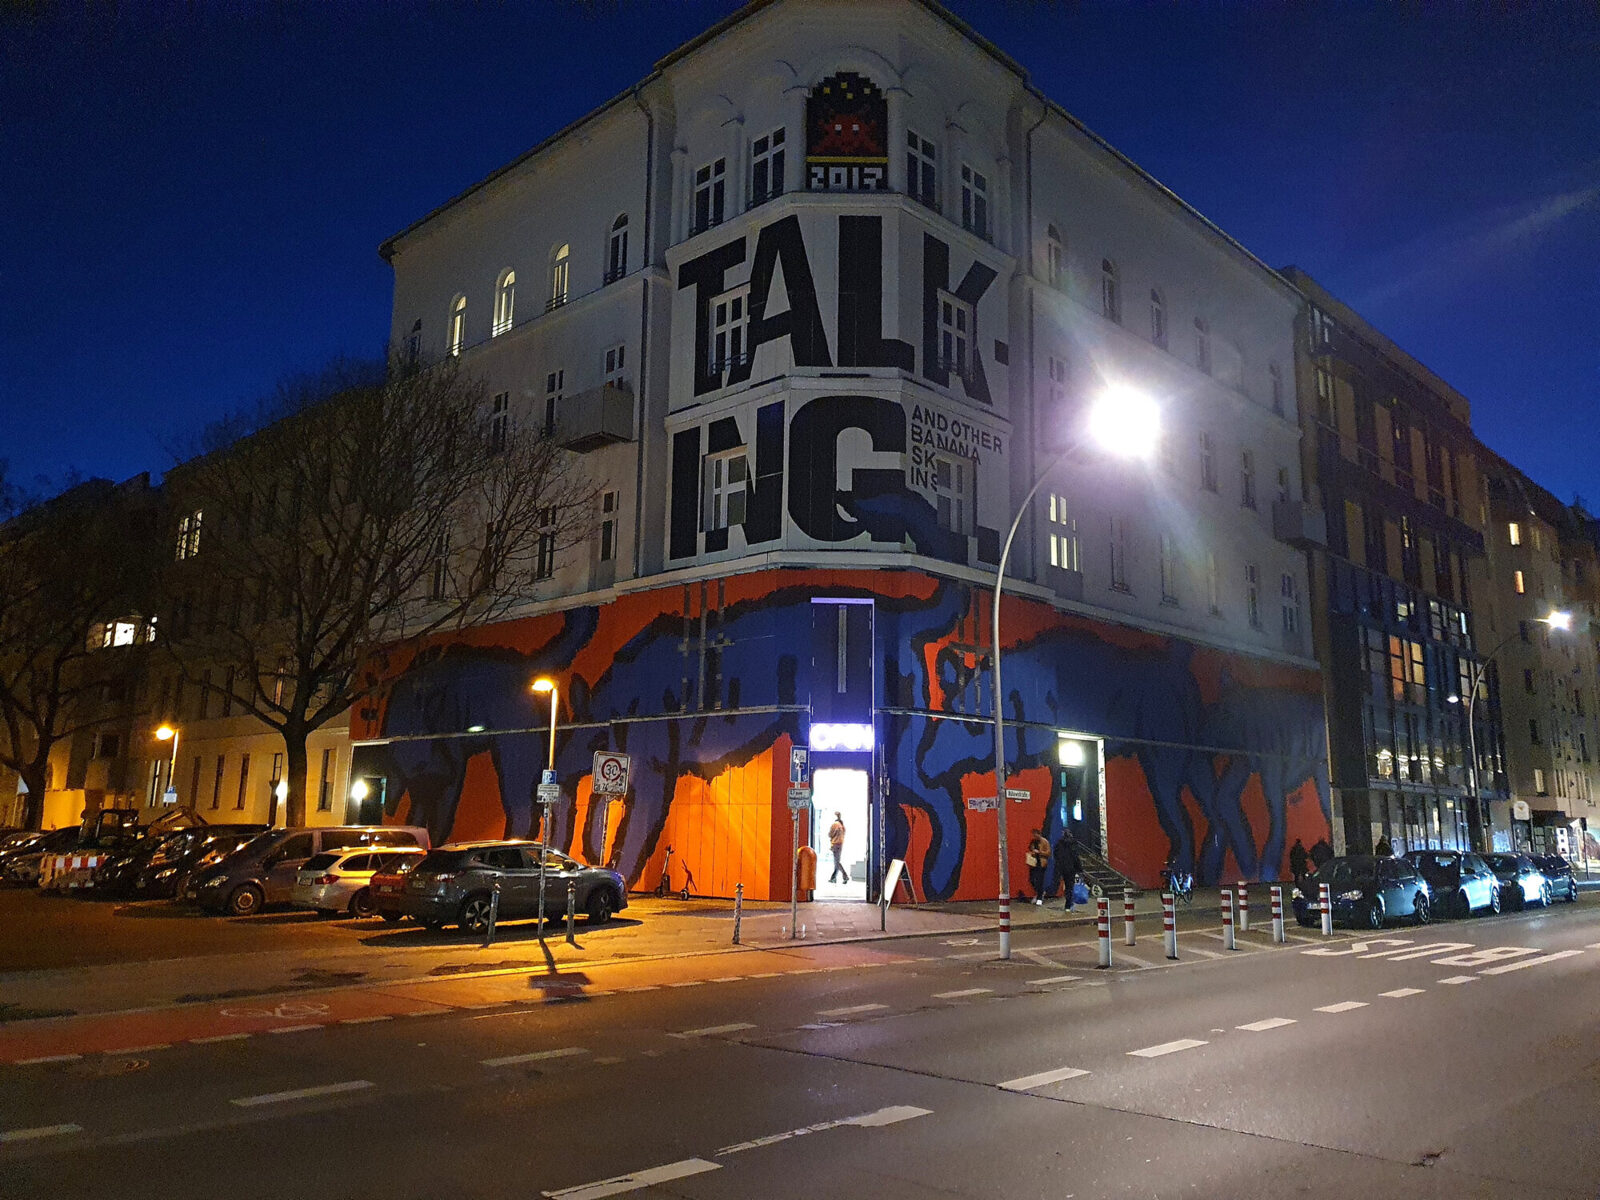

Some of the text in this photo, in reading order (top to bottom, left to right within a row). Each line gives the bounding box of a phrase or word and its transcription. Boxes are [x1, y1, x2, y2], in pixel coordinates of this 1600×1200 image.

[911, 404, 1003, 454] AND OTHER
[911, 423, 981, 465] BANANA
[911, 445, 936, 470] SK
[605, 764, 618, 776] 30
[1300, 939, 1542, 967] BUS
